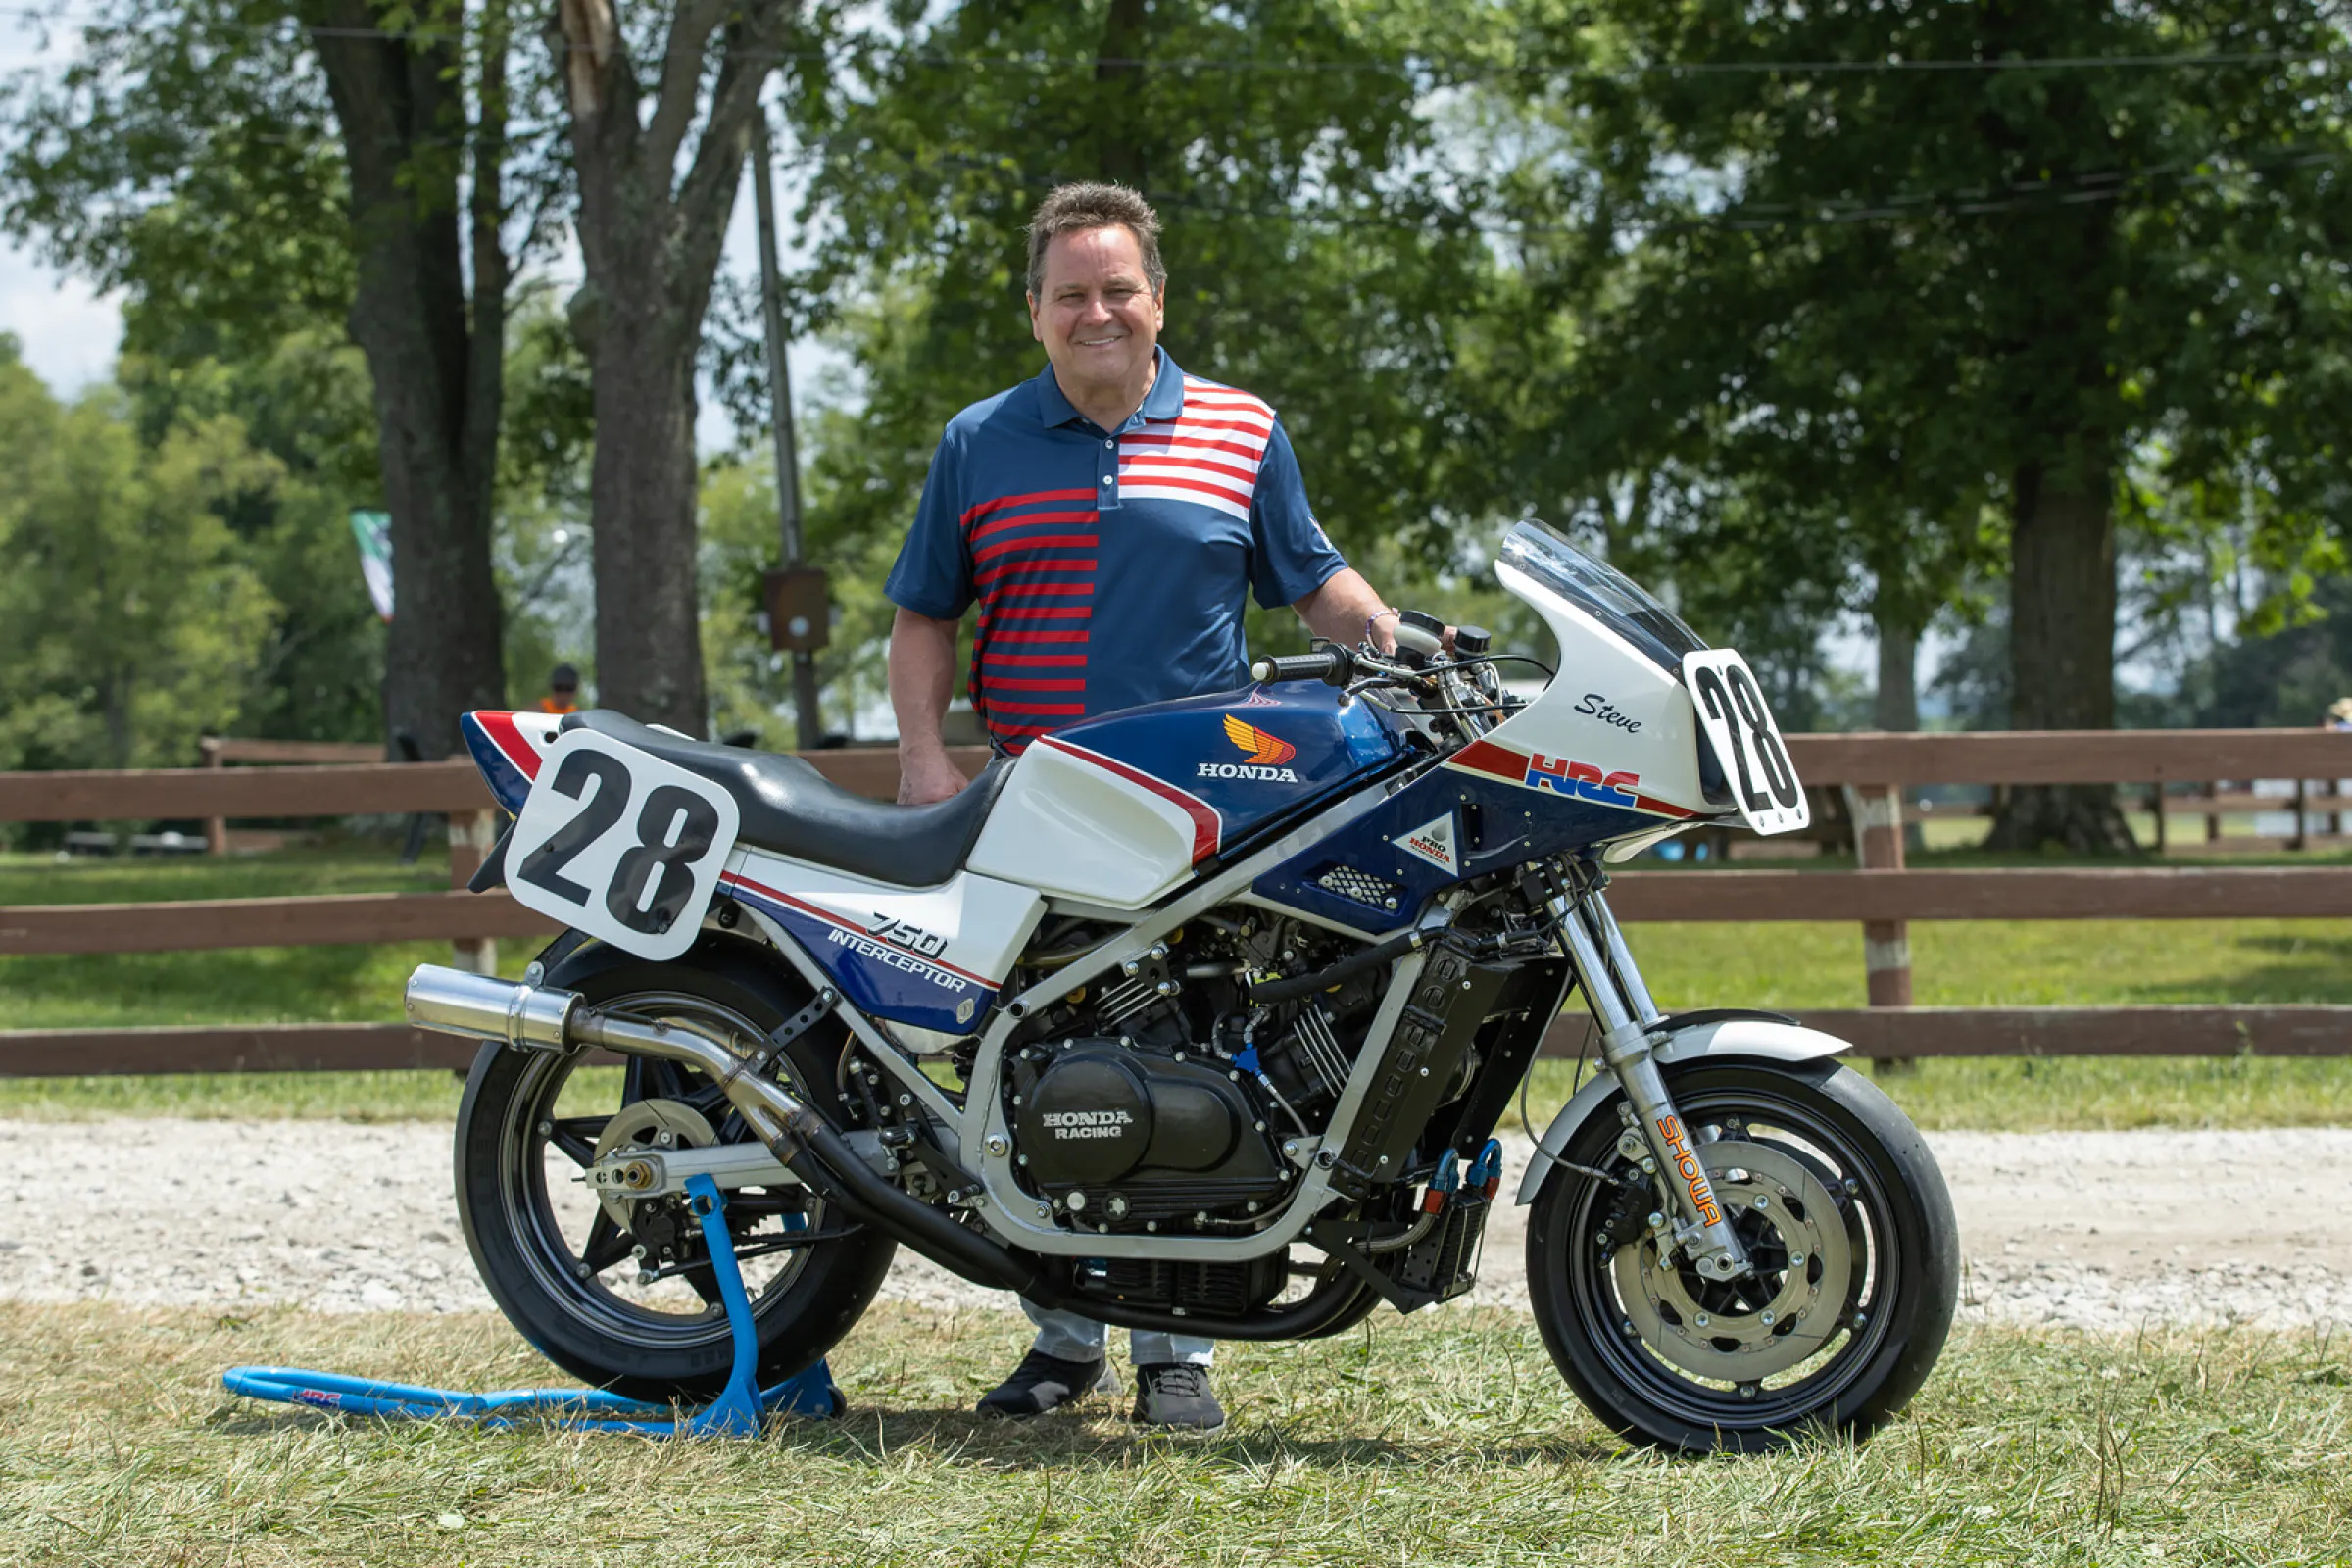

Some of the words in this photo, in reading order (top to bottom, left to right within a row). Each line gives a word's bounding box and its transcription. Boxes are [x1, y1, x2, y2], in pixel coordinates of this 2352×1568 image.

[1573, 693, 1642, 734] Steve
[1695, 664, 1798, 812] 28
[1197, 762, 1298, 783] HONDA
[1525, 752, 1641, 808] HRC
[516, 748, 719, 935] 28
[1409, 836, 1450, 863] HONDA
[1421, 835, 1447, 853] PRO
[866, 911, 949, 960] 750
[827, 929, 967, 993] INTERCEPTOR
[1042, 1110, 1134, 1127] HONDA
[1054, 1125, 1123, 1140] RACING
[1656, 1114, 1723, 1228] SHOWA
